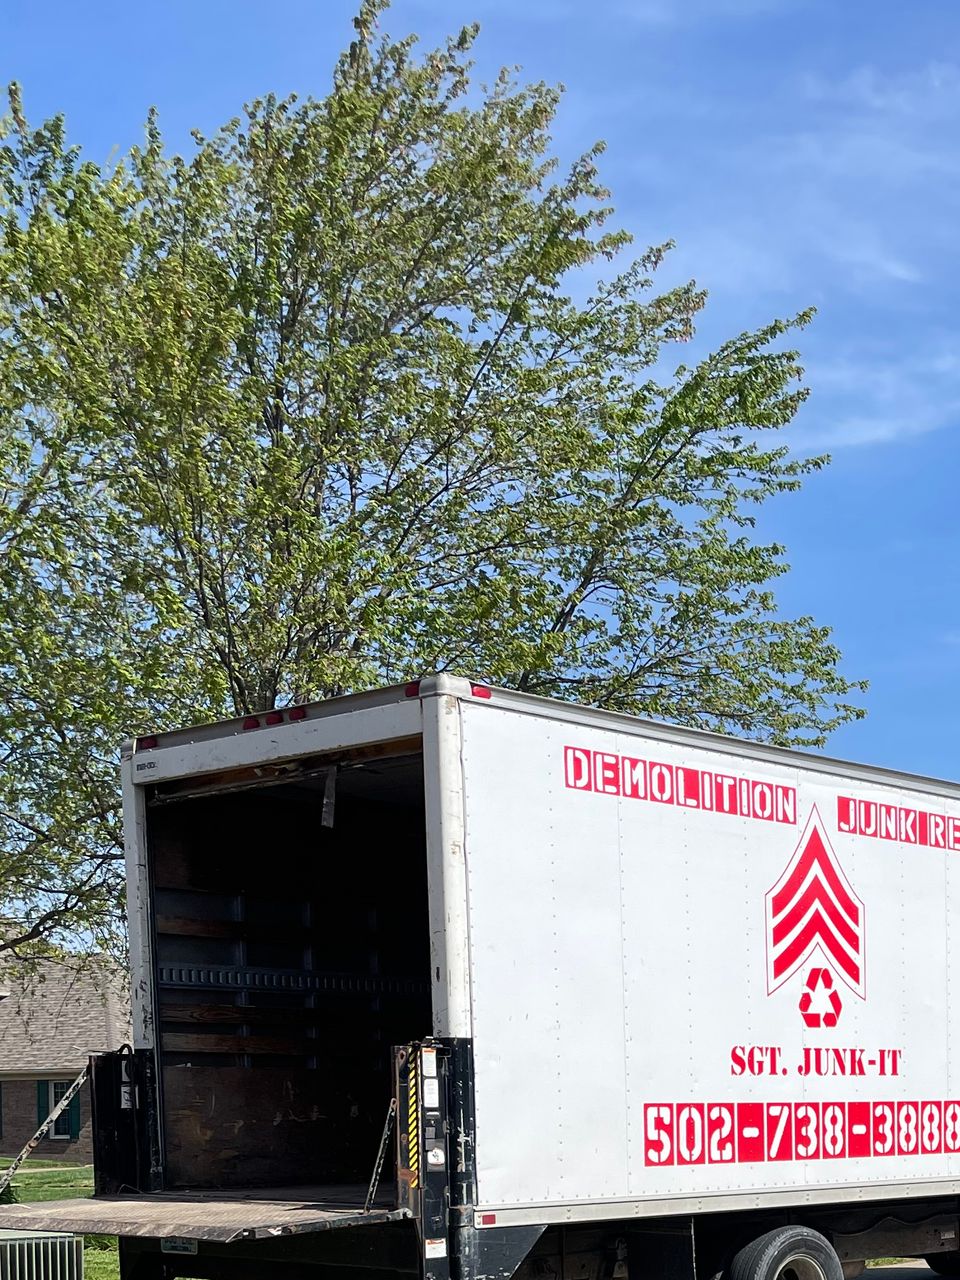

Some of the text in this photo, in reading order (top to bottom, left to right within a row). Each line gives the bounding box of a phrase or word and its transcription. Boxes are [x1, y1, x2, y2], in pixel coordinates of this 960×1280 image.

[565, 747, 796, 823] DEMOLITION
[838, 798, 917, 843] JUNK
[731, 1046, 902, 1077] SGT. JUNK-IT
